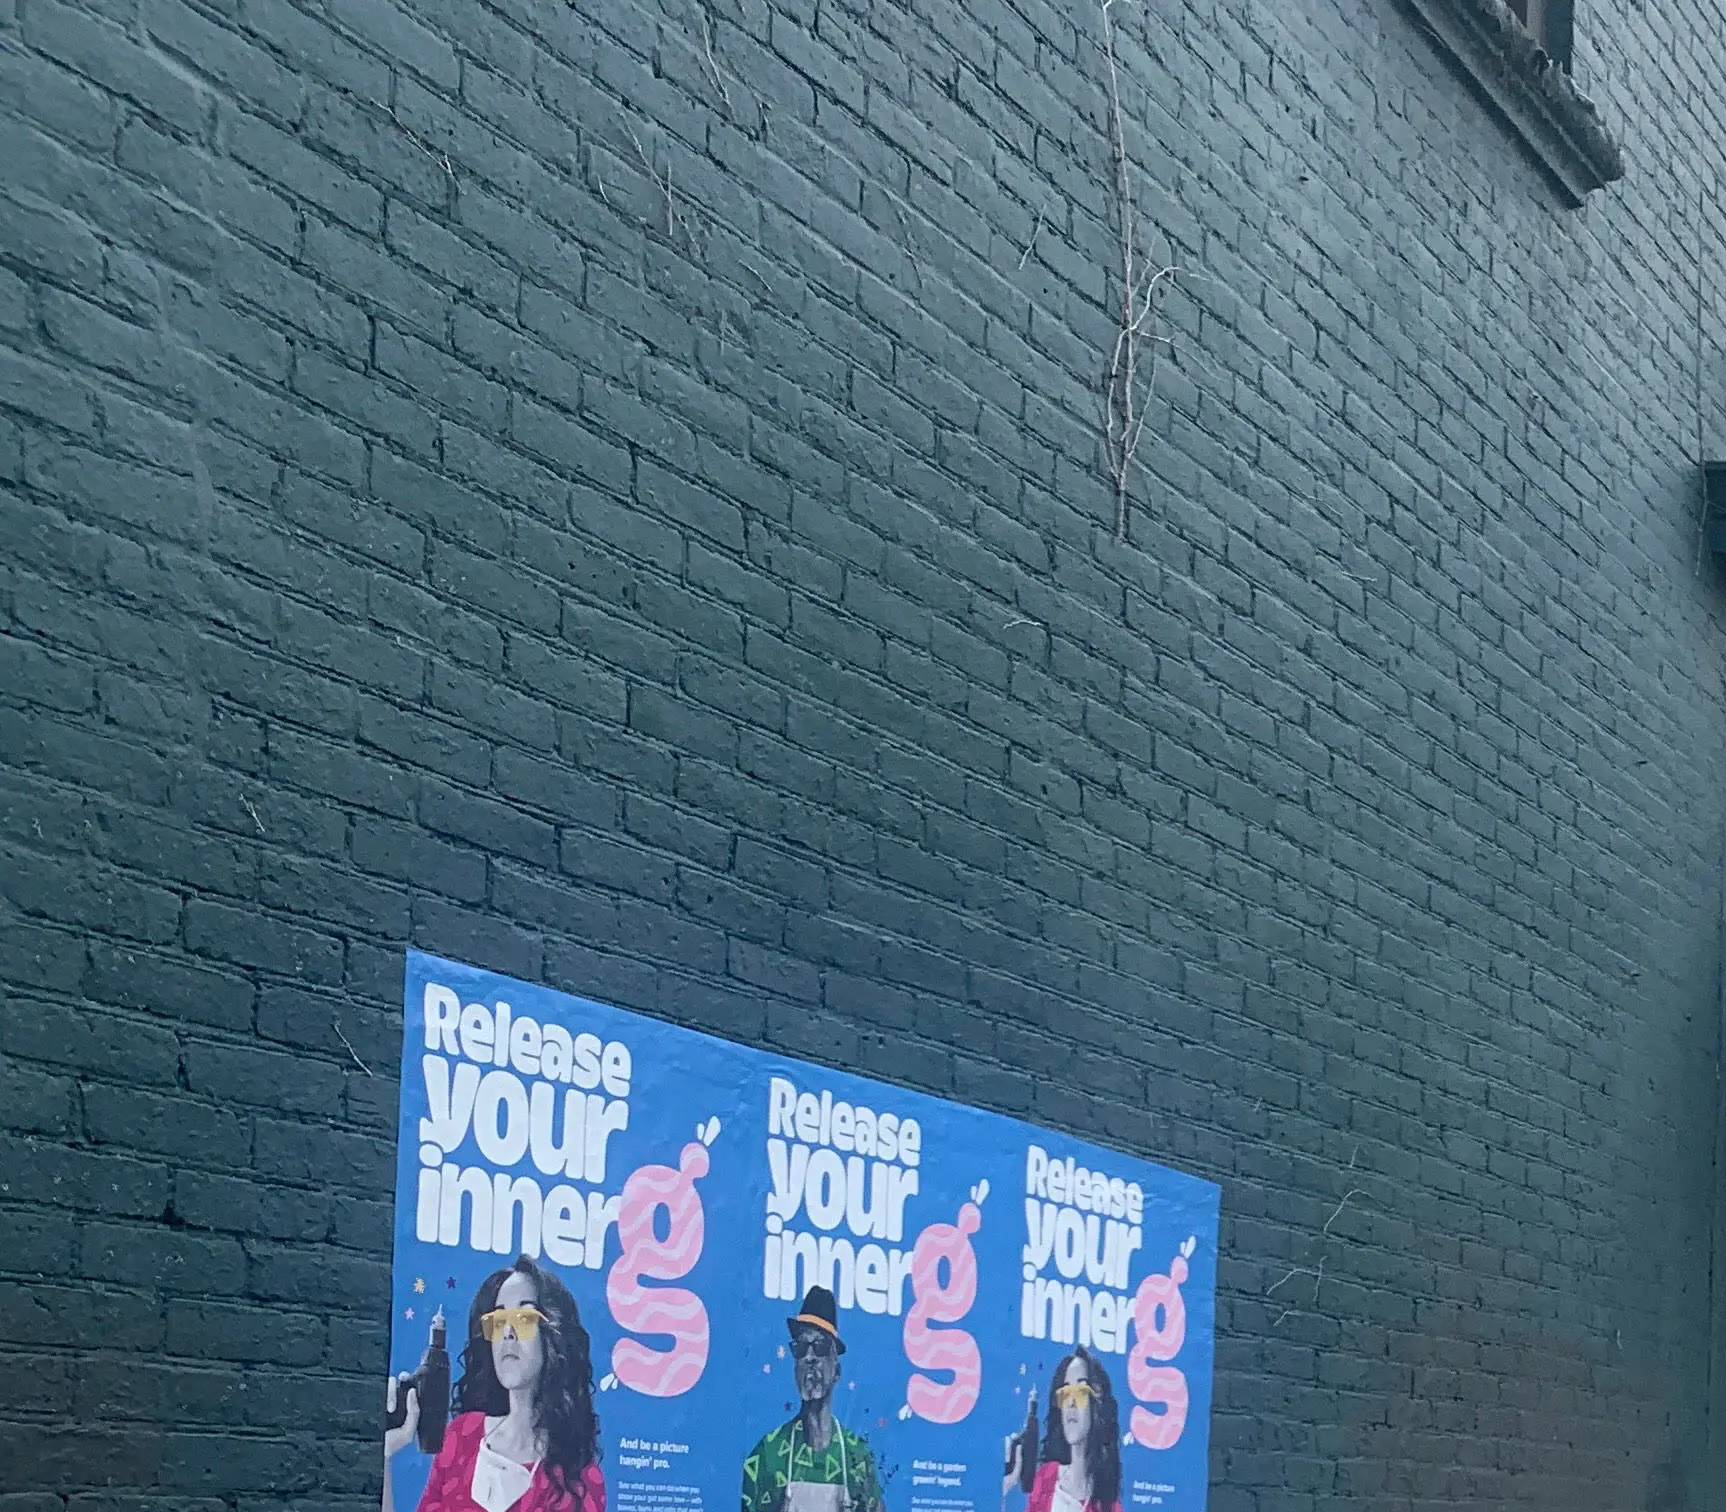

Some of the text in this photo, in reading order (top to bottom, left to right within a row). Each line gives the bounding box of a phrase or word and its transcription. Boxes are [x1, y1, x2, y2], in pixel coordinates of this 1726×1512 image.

[424, 982, 631, 1097] Release
[419, 1055, 629, 1183] your
[769, 1077, 921, 1166] Release
[416, 1141, 620, 1270] inner
[766, 1138, 919, 1242] your
[1026, 1145, 1143, 1225] Release
[764, 1214, 913, 1317] inner
[1023, 1199, 1142, 1289] your
[1021, 1263, 1136, 1354] inner
[620, 1438, 638, 1449] And
[640, 1440, 651, 1450] be
[660, 1441, 689, 1454] picture
[654, 1460, 670, 1470] pro.
